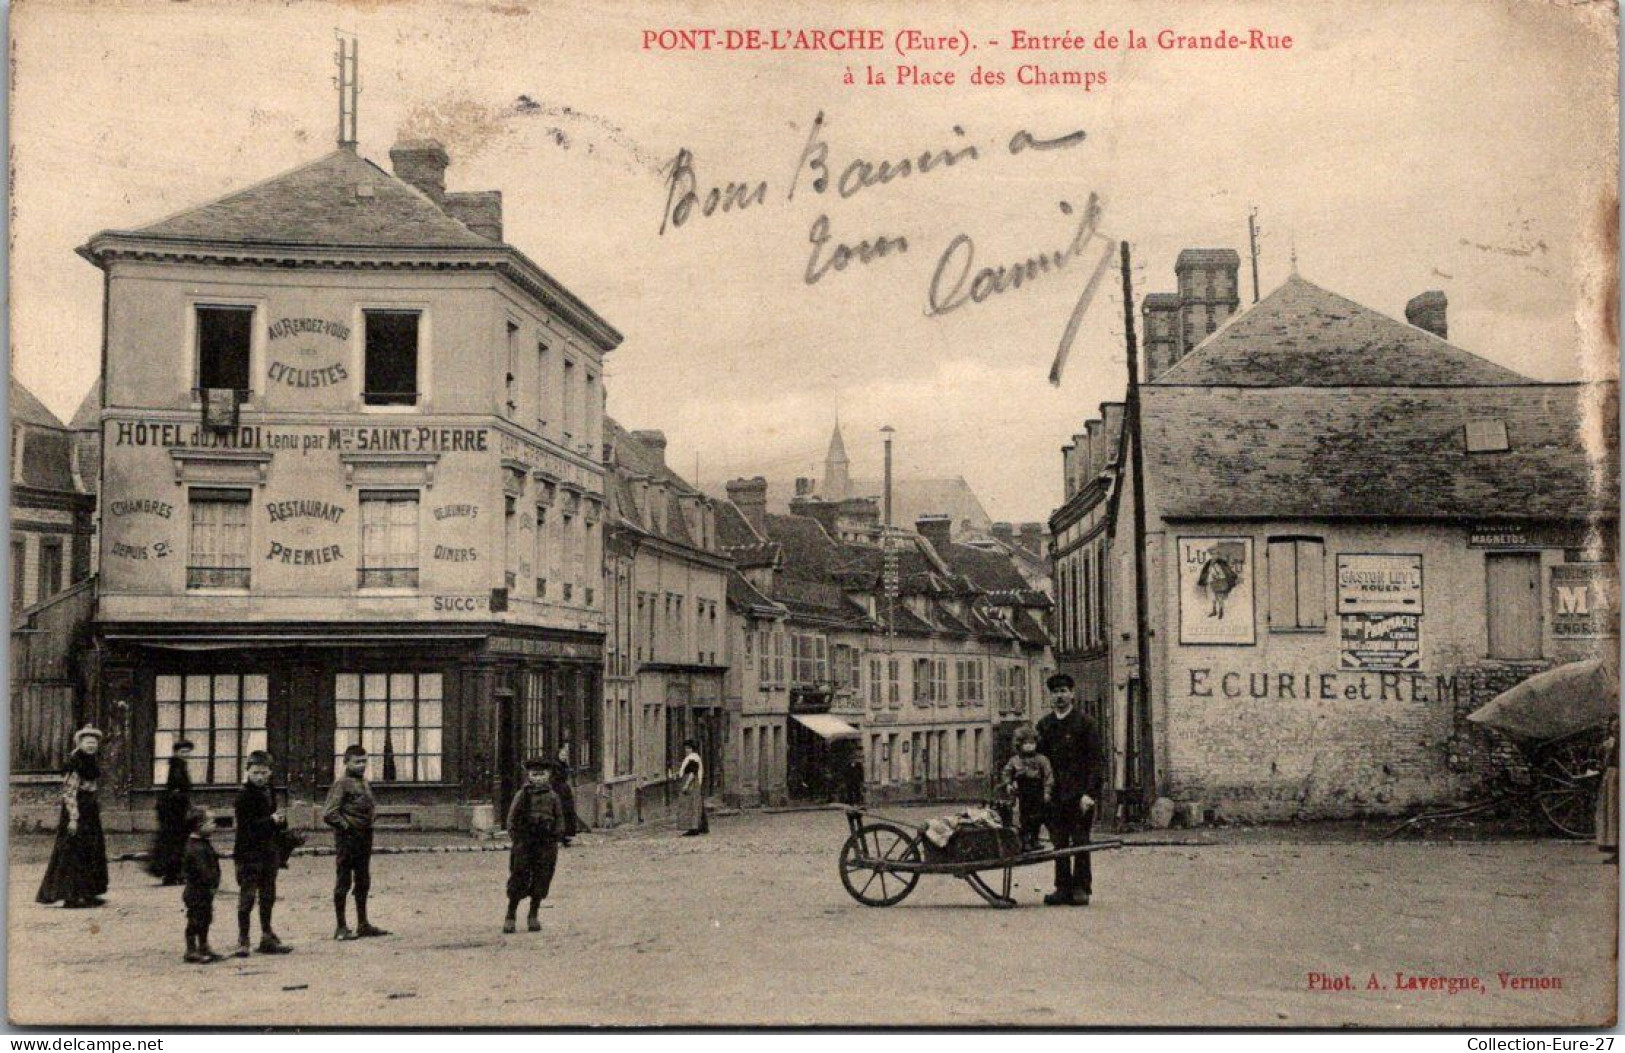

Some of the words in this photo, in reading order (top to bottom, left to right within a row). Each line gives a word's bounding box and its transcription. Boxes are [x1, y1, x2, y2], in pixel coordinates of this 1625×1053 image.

[268, 361, 348, 387] CYCLISTES
[266, 430, 299, 449] tenu
[303, 433, 325, 456] par
[356, 427, 488, 452] SAINT-PIERRE
[110, 499, 174, 519] CHAMBRES
[266, 500, 346, 523] RESTAURANT
[111, 542, 149, 560] DEPUIS
[265, 541, 344, 566] PREMIER
[1361, 584, 1401, 592] ROUEN
[1188, 667, 1338, 700] ECURIE
[1344, 674, 1369, 700] et
